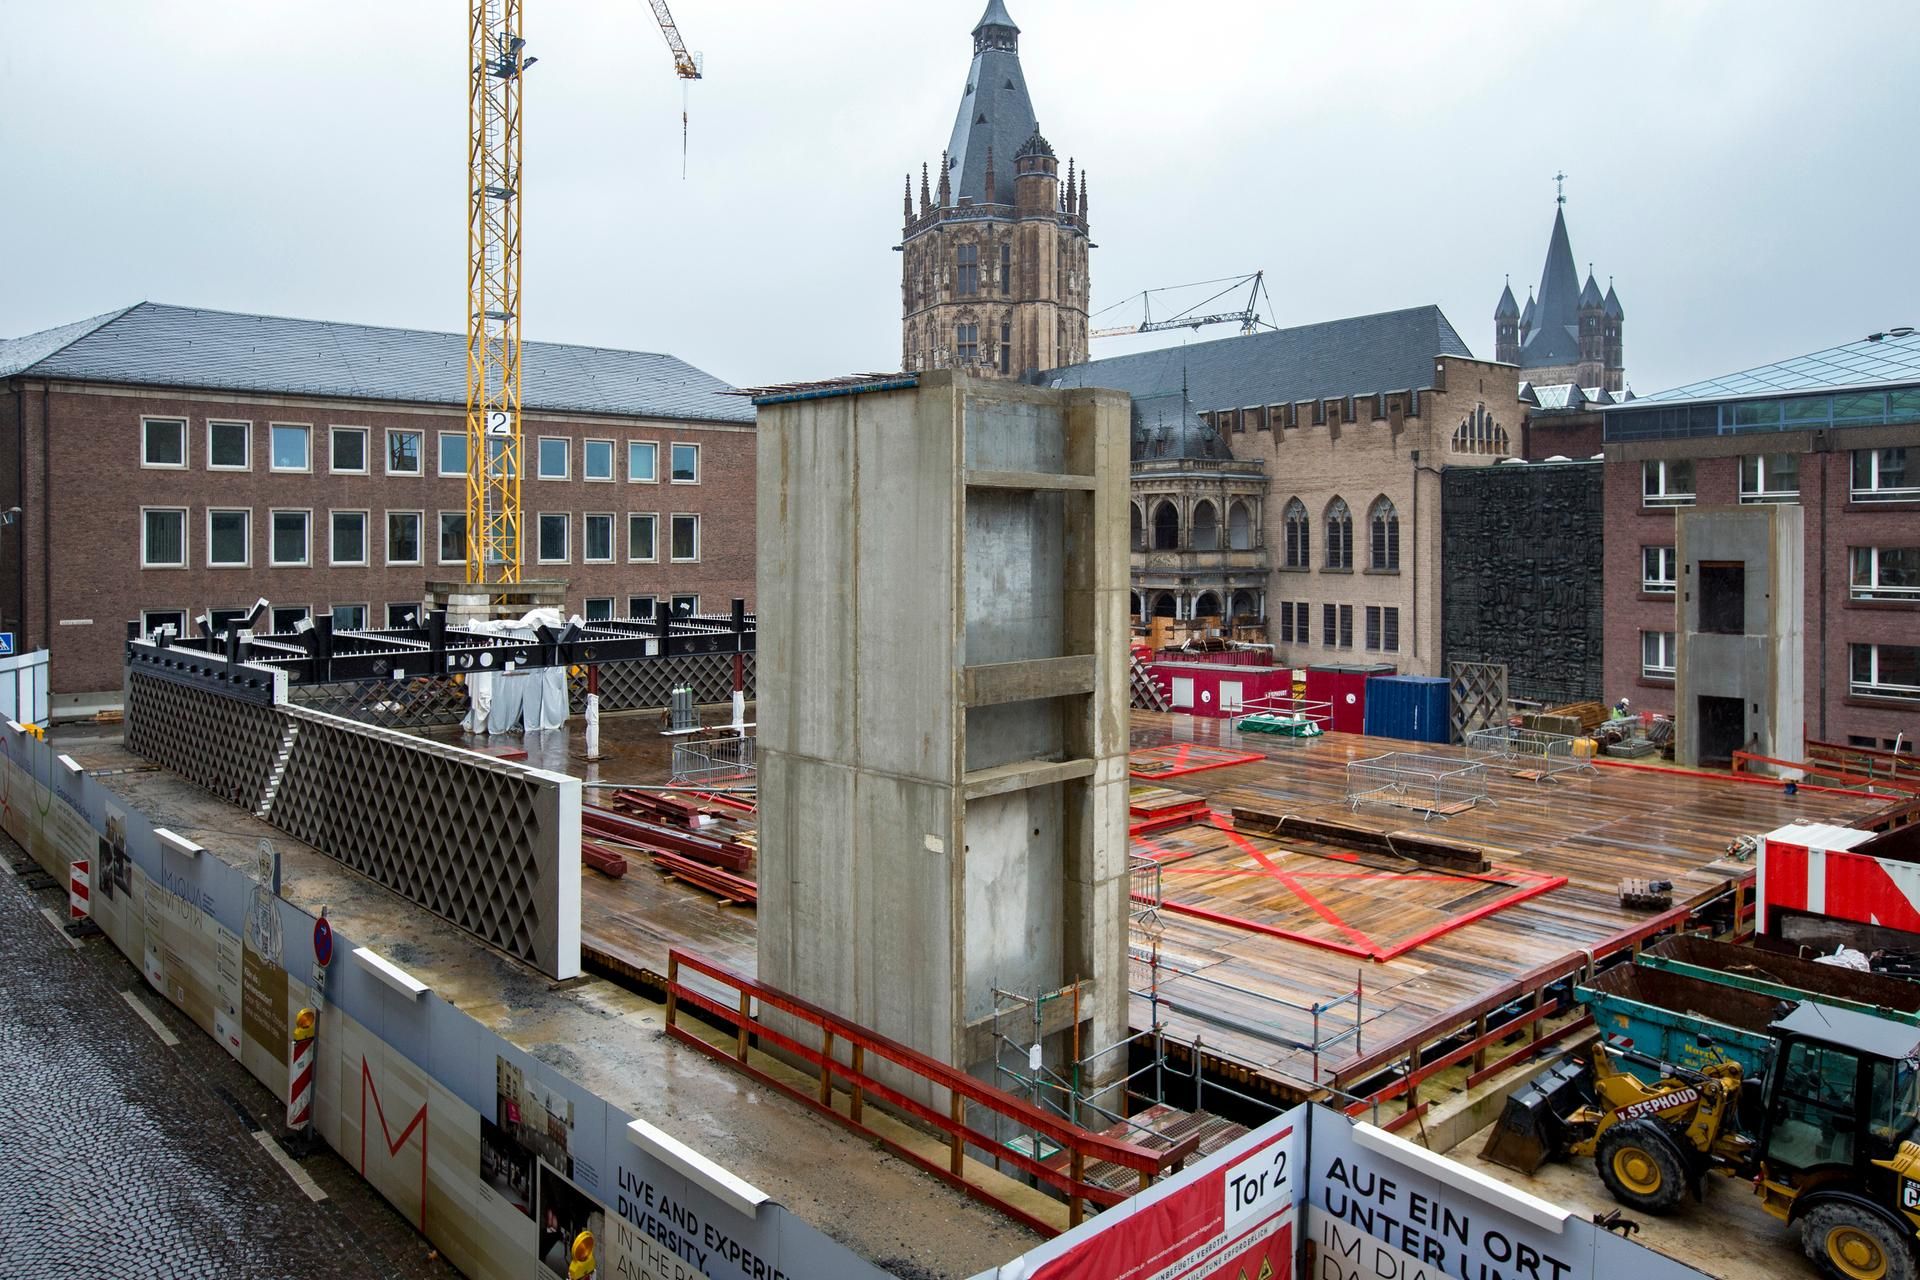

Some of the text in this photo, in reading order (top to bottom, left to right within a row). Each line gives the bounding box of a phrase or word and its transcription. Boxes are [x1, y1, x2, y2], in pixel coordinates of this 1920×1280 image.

[492, 412, 507, 433] 2
[1230, 1150, 1287, 1212] Tor 2
[617, 1223, 633, 1252] IN
[636, 1236, 670, 1279] THE
[618, 1166, 654, 1208] LIVE
[659, 1195, 698, 1236] AND
[704, 1223, 790, 1280] EXPERIE
[618, 1195, 710, 1278] DIVERSITY.
[1324, 1220, 1361, 1264] IM
[1325, 1157, 1572, 1280] AUF EIN ORT
[1325, 1186, 1446, 1273] UNTER
